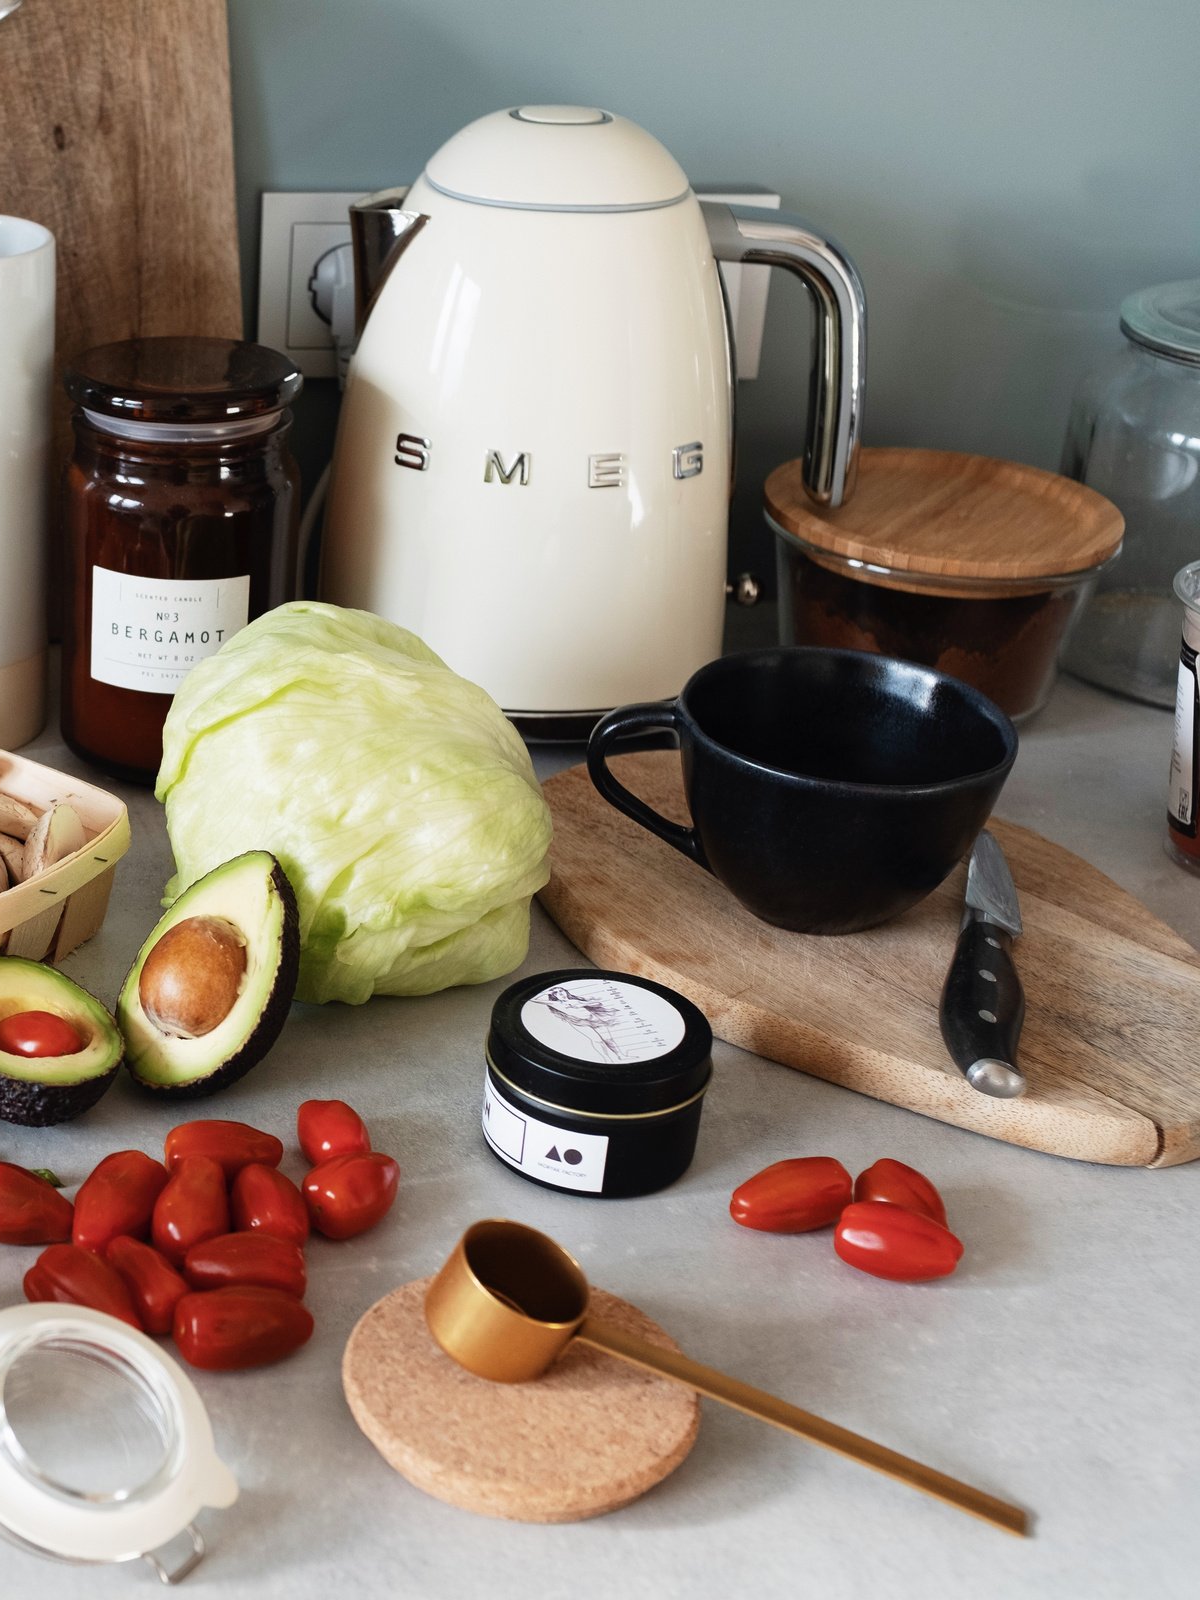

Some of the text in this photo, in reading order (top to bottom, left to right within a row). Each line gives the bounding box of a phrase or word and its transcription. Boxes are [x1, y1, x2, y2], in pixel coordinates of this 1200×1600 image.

[394, 433, 704, 489] SMEG
[111, 622, 225, 644] BERGAMOT
[138, 652, 152, 660] NET
